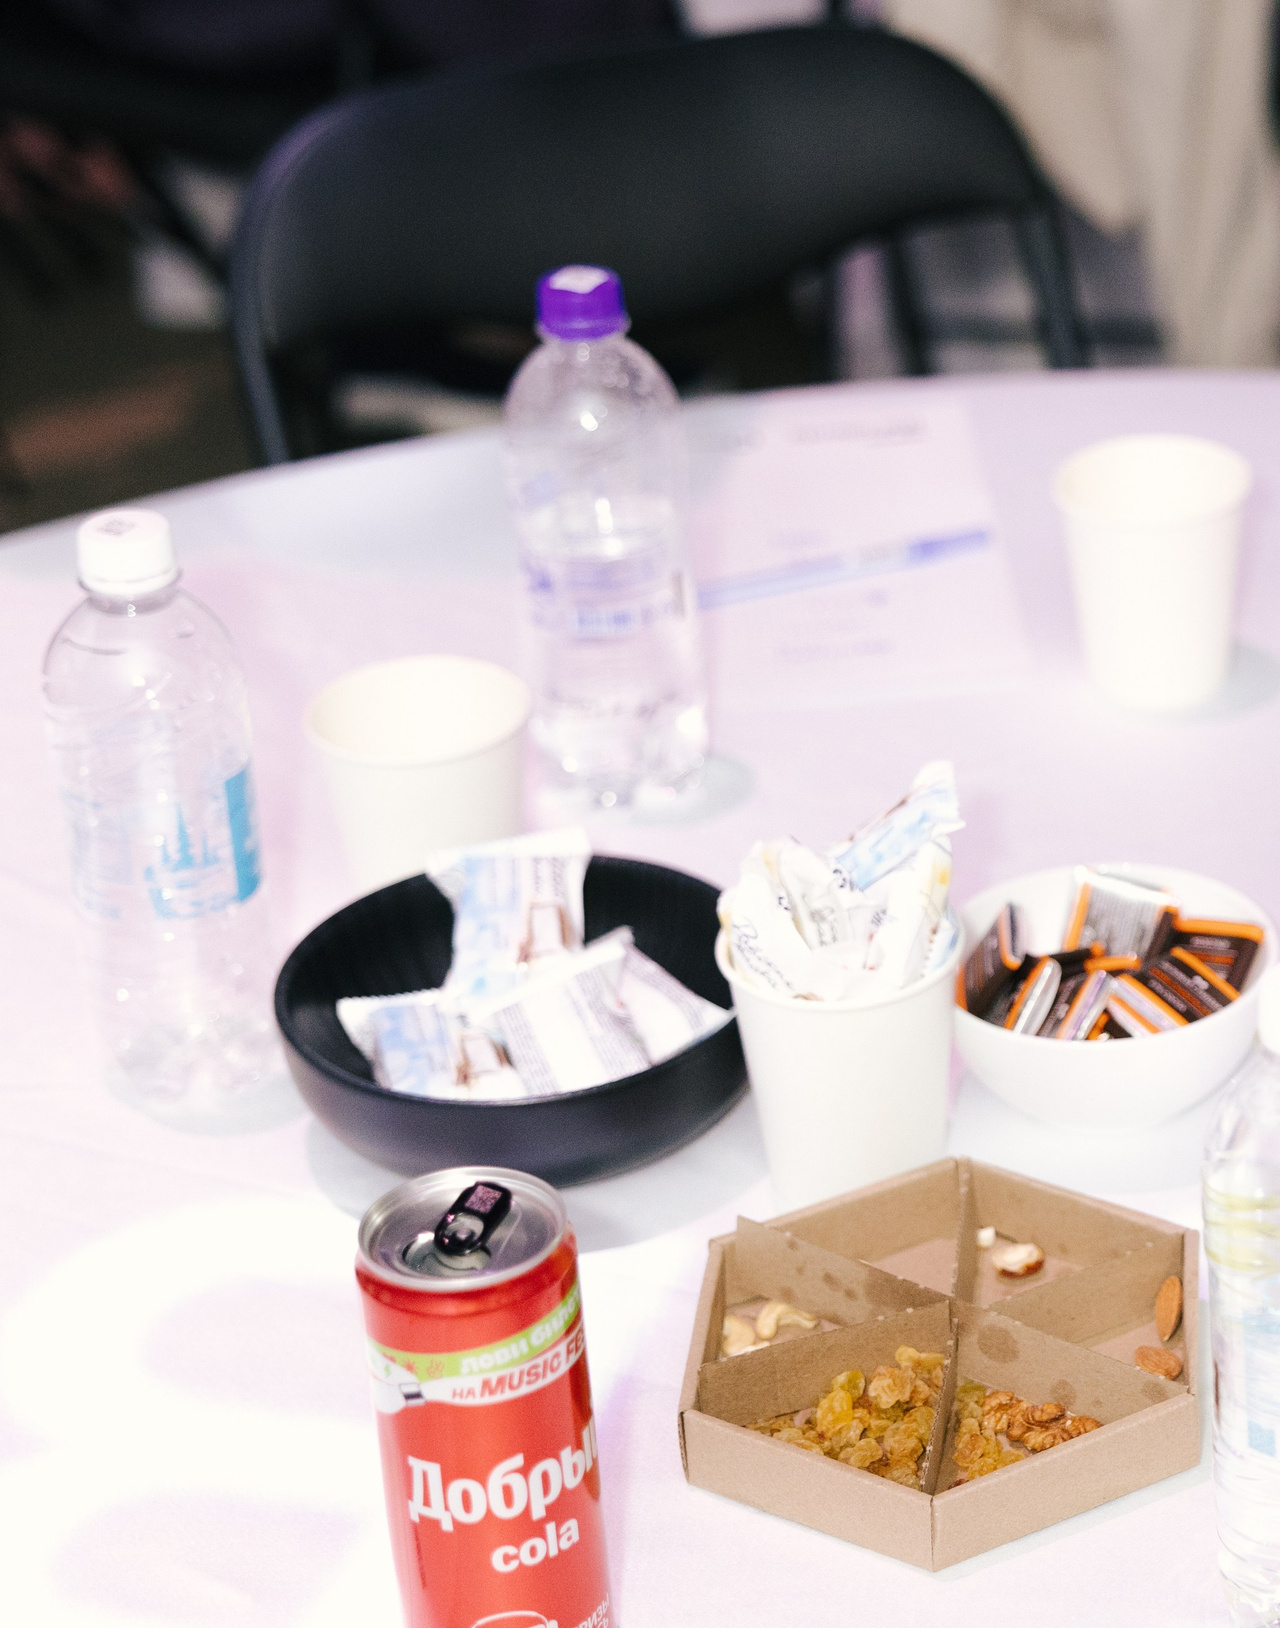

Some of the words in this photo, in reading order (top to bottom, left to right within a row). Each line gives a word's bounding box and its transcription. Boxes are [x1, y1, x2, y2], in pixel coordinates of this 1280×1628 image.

[480, 1351, 561, 1398] MUSIC
[407, 1415, 598, 1532] Добры
[491, 1518, 580, 1573] cola
